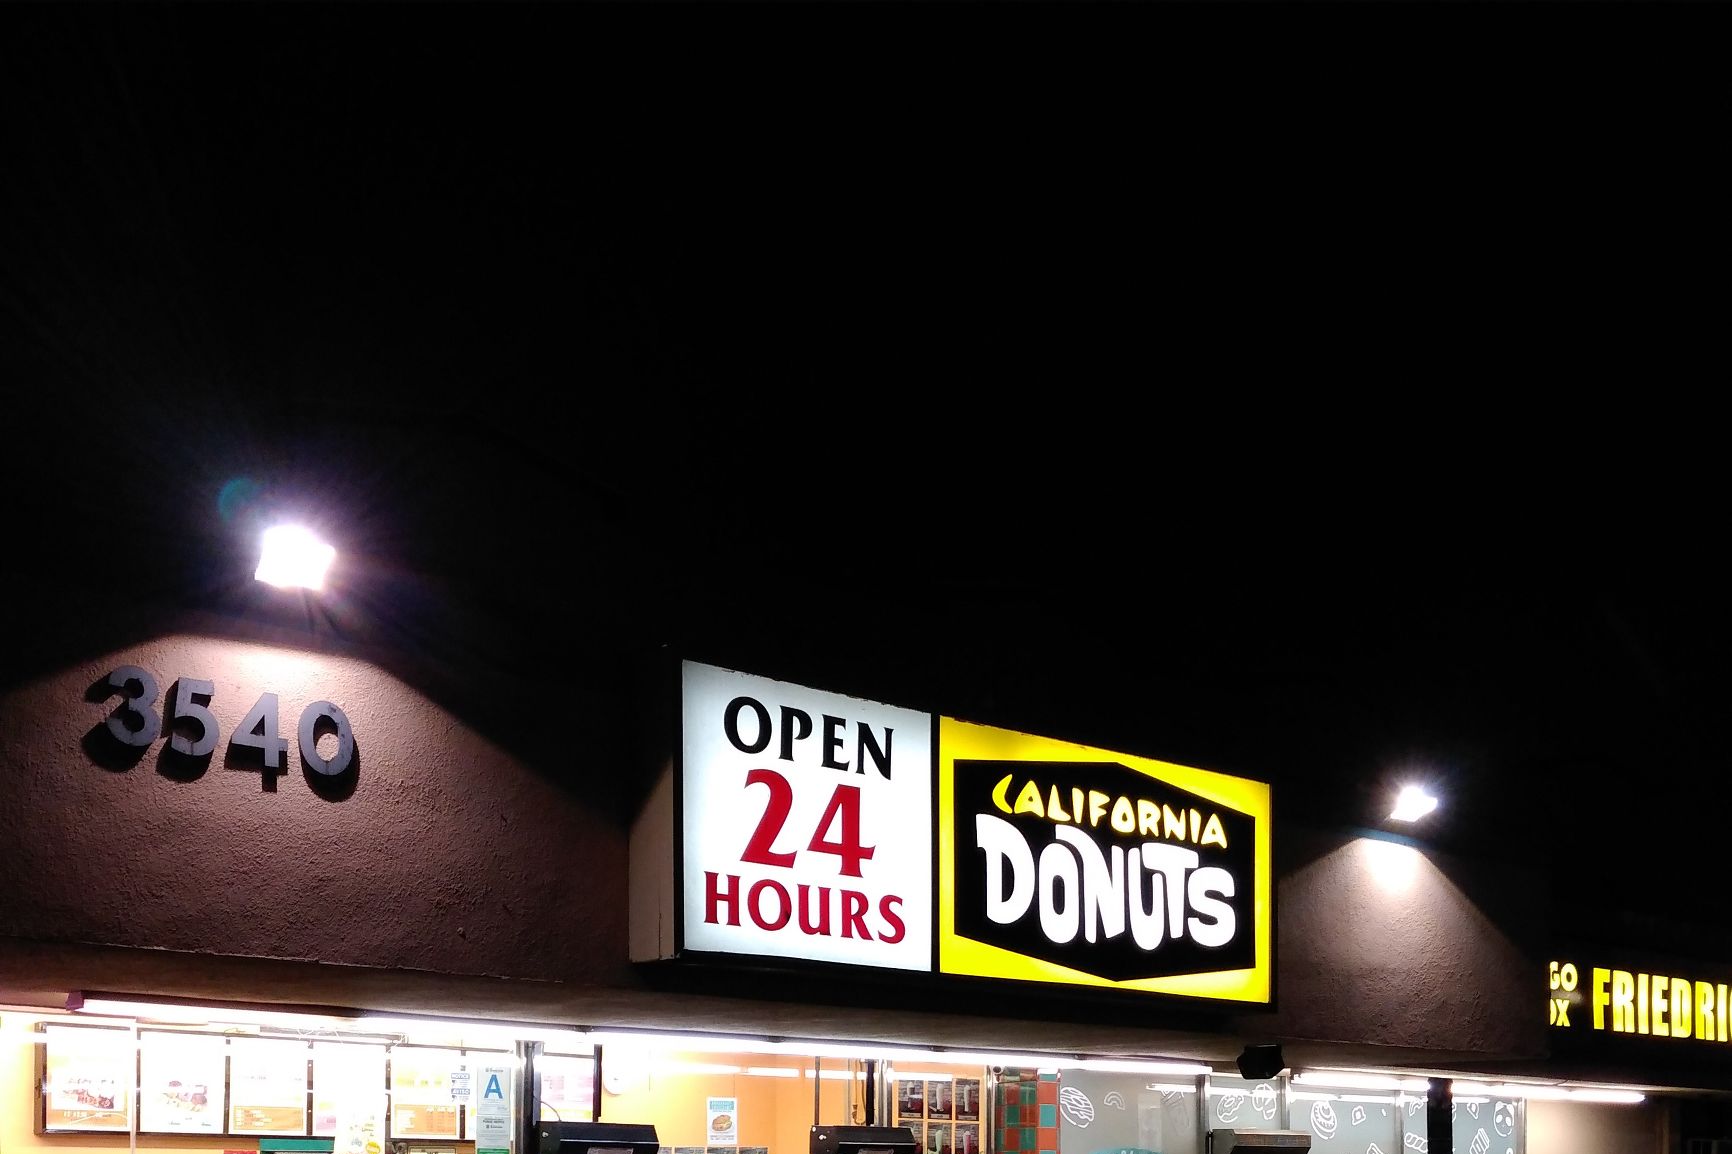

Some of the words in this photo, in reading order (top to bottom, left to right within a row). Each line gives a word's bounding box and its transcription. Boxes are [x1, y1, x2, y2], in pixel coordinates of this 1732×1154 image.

[107, 665, 354, 776] 3540
[724, 696, 894, 780] OPEN
[740, 769, 876, 878] 24
[992, 774, 1227, 849] CALIFORNIA
[704, 871, 906, 944] HOURS
[976, 813, 1236, 950] DONUTS
[1550, 961, 1578, 992] GO
[1593, 967, 1732, 1042] FRIEDRI
[484, 1074, 503, 1099] A
